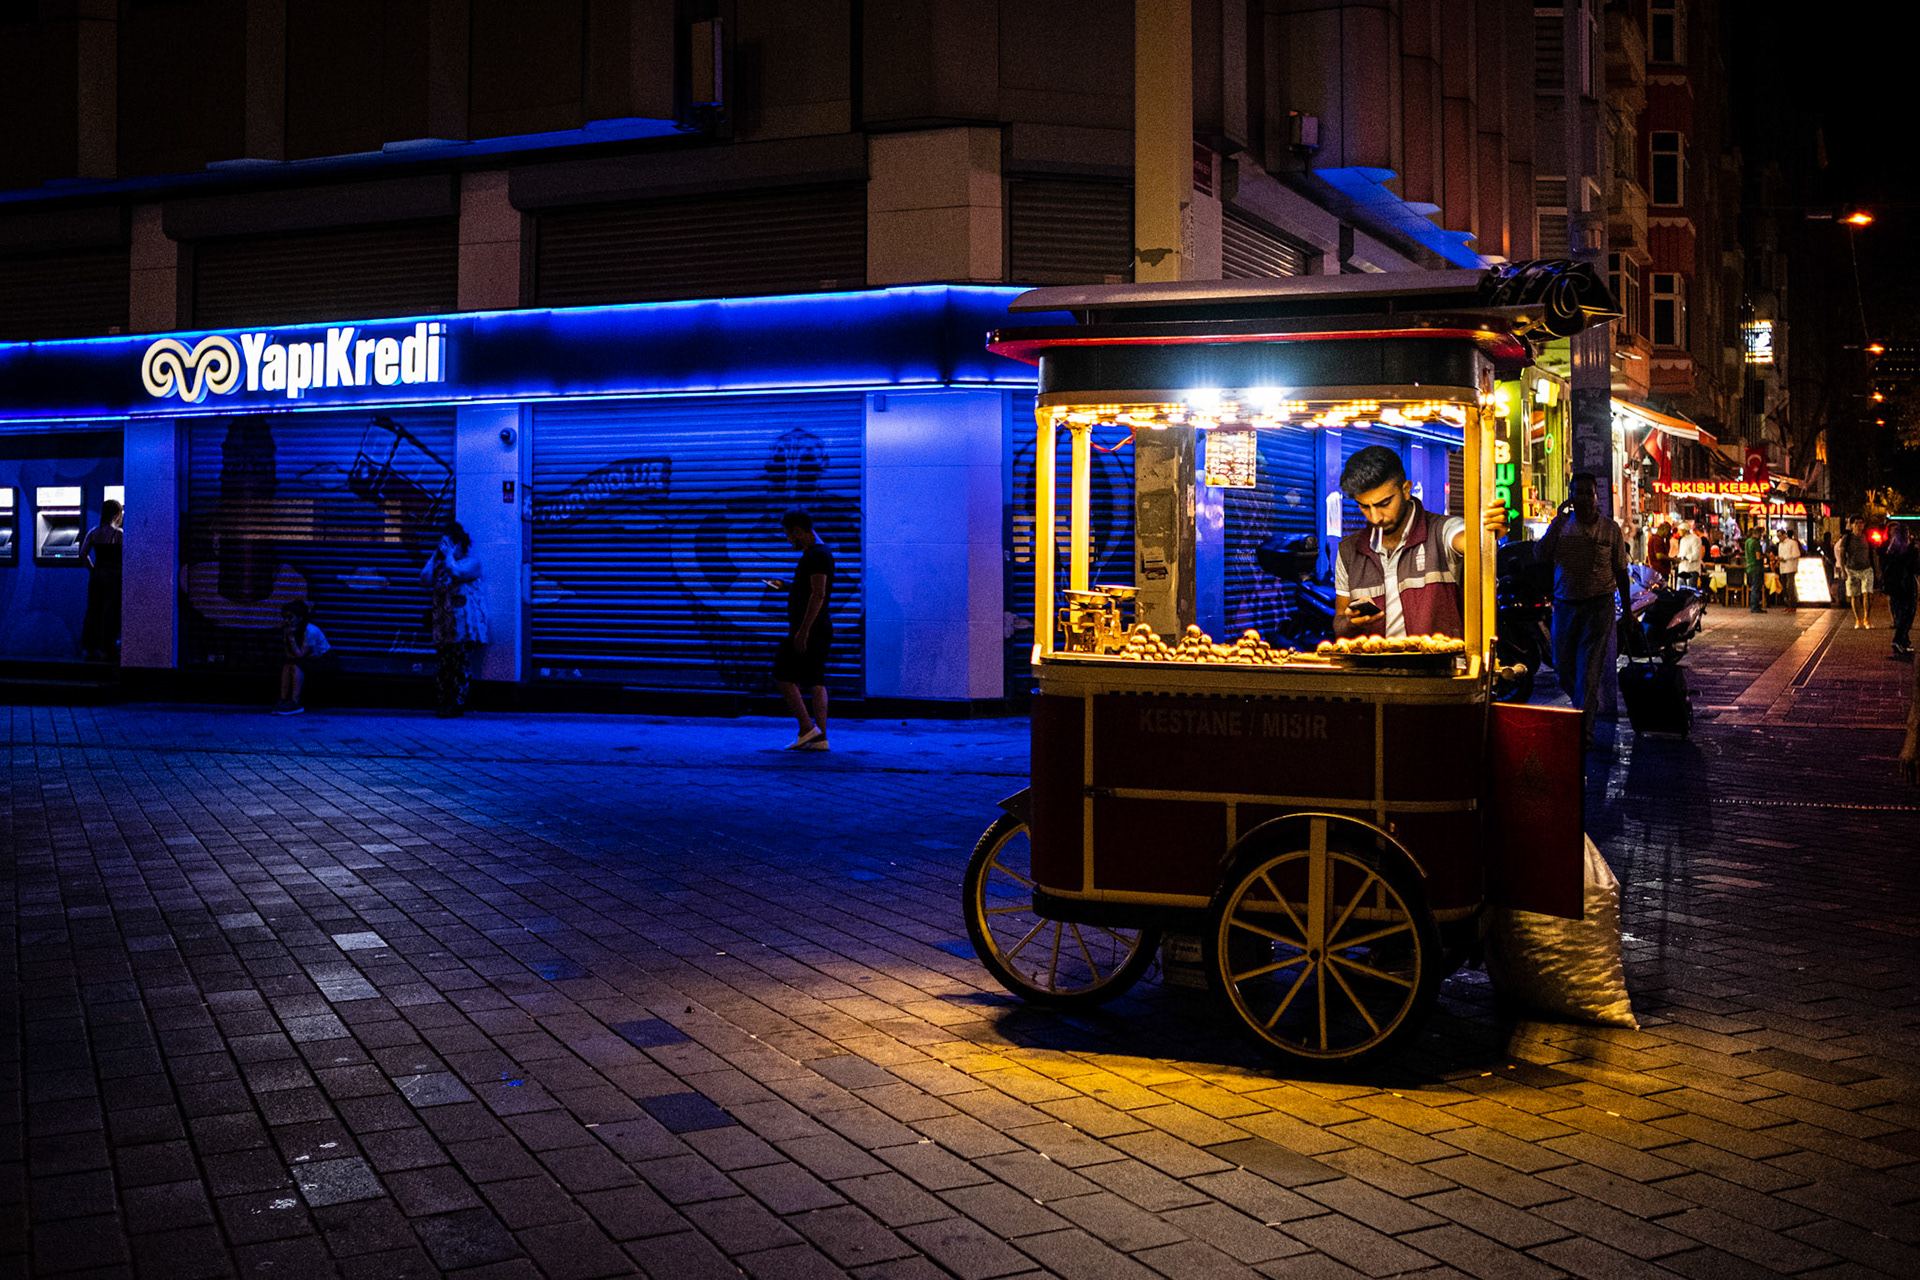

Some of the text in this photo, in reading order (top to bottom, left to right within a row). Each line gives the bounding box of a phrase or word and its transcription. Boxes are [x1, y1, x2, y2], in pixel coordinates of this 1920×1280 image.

[1652, 480, 1770, 493] TURKISH KEBAP
[1139, 708, 1243, 736] KESTANE
[1262, 712, 1328, 740] MISIR
